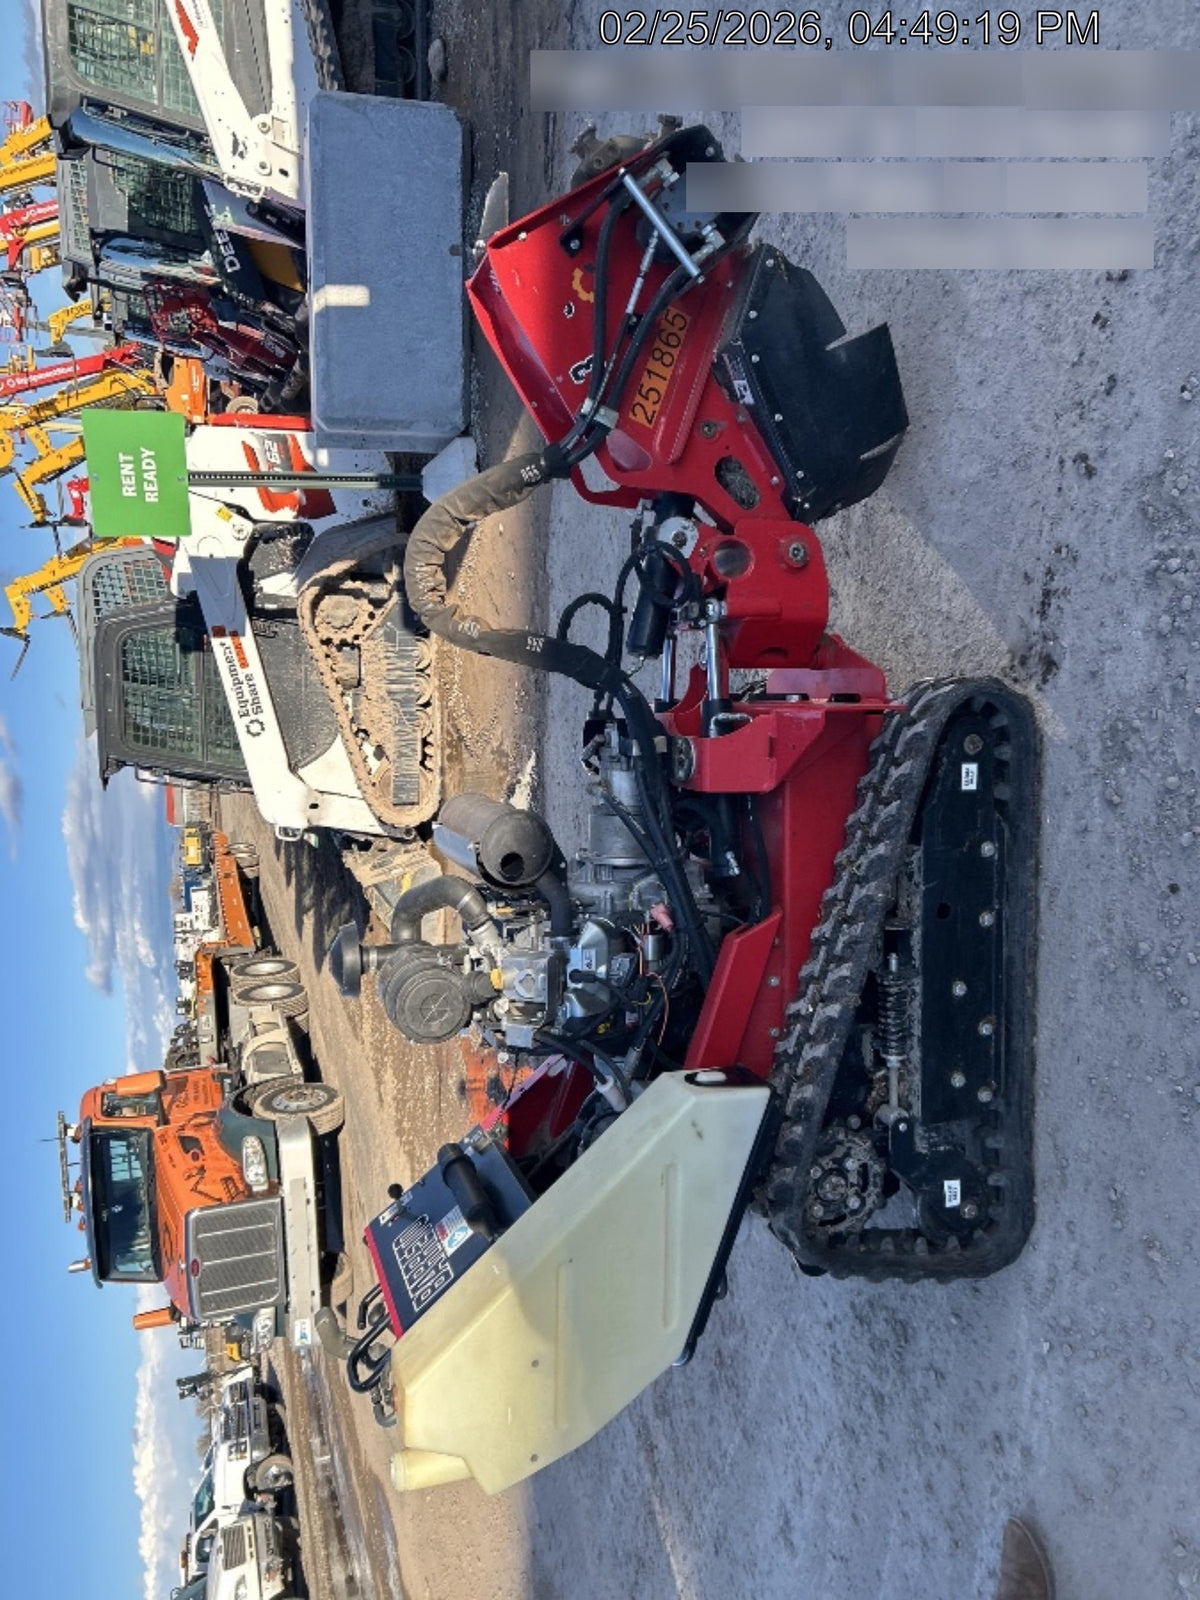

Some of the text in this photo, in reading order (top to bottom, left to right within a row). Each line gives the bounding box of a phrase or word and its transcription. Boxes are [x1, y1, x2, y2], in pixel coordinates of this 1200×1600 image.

[631, 308, 687, 425] 251865
[118, 452, 137, 498] RENT
[140, 447, 159, 502] READY
[219, 641, 249, 718] Equipment
[244, 673, 263, 716] Share
